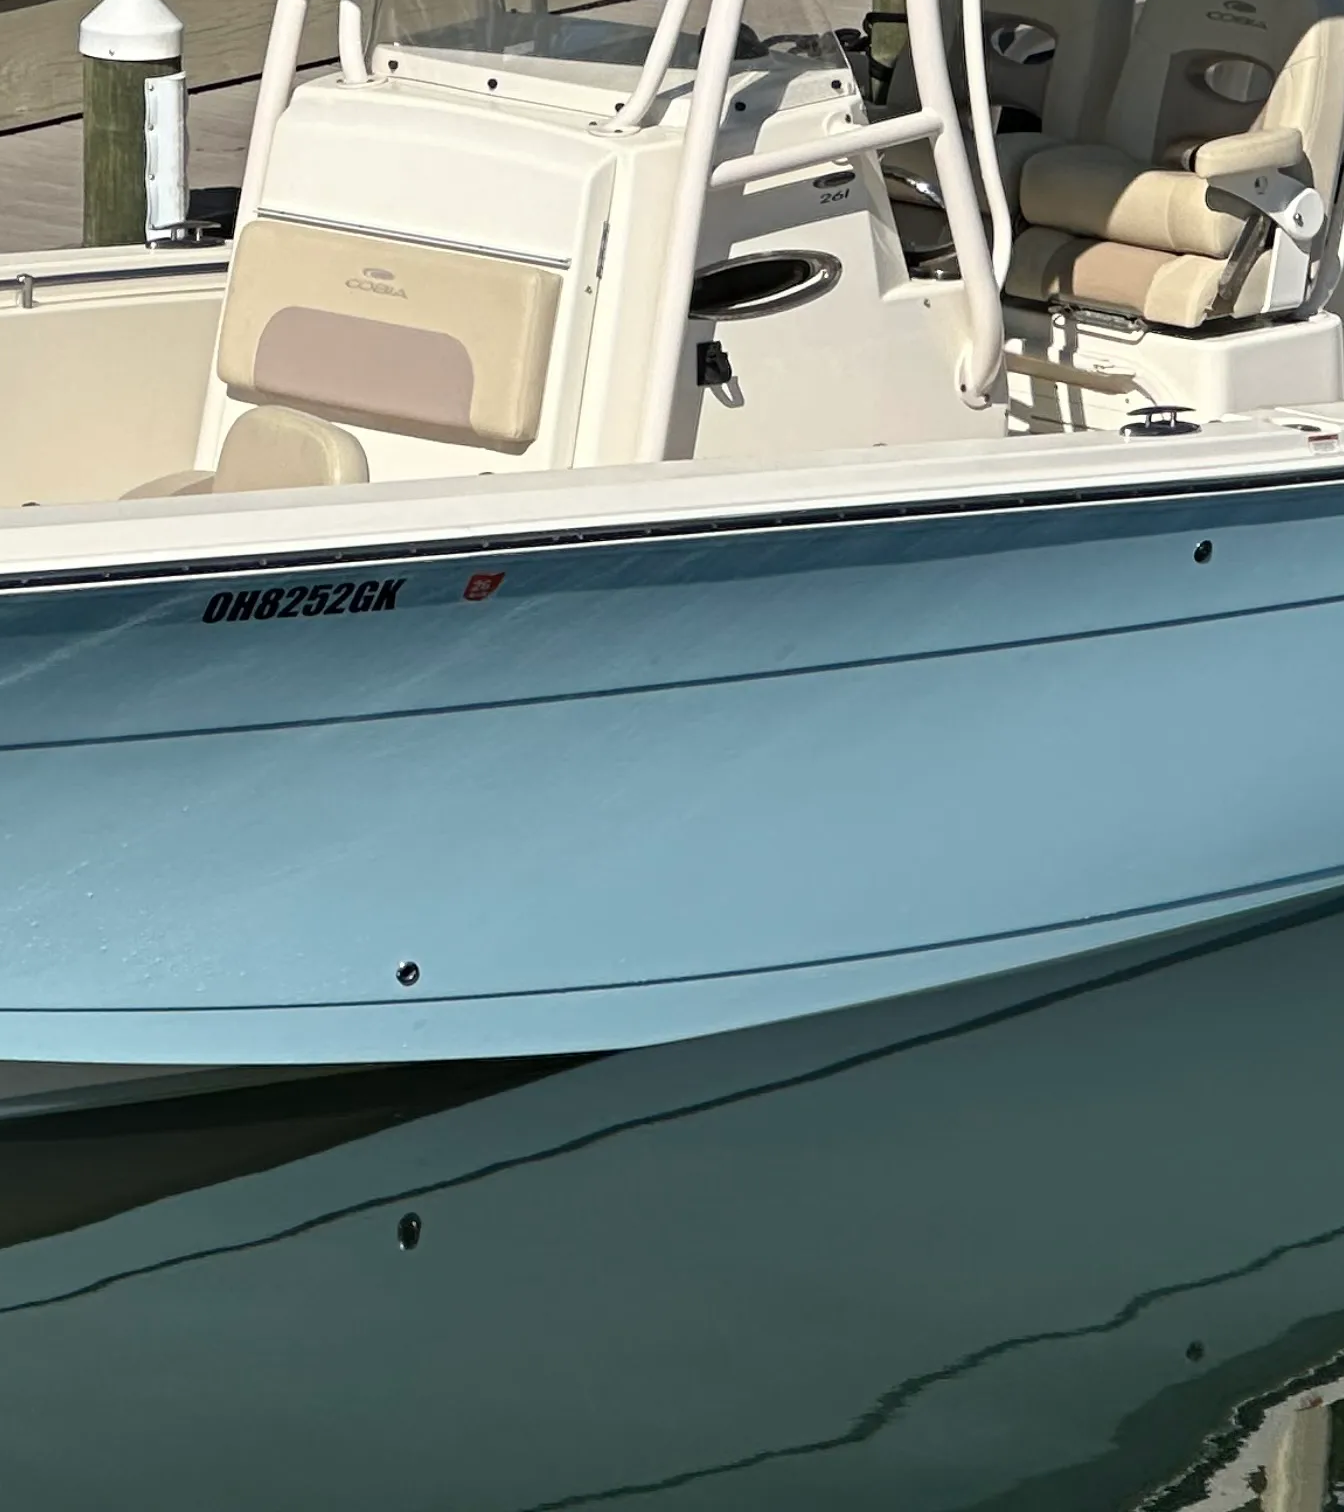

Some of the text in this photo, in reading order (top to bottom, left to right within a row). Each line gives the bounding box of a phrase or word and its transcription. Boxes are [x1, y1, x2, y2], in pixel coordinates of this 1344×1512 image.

[1205, 10, 1268, 31] COBIA
[345, 278, 409, 301] COBIA
[202, 577, 408, 624] OH8252GK
